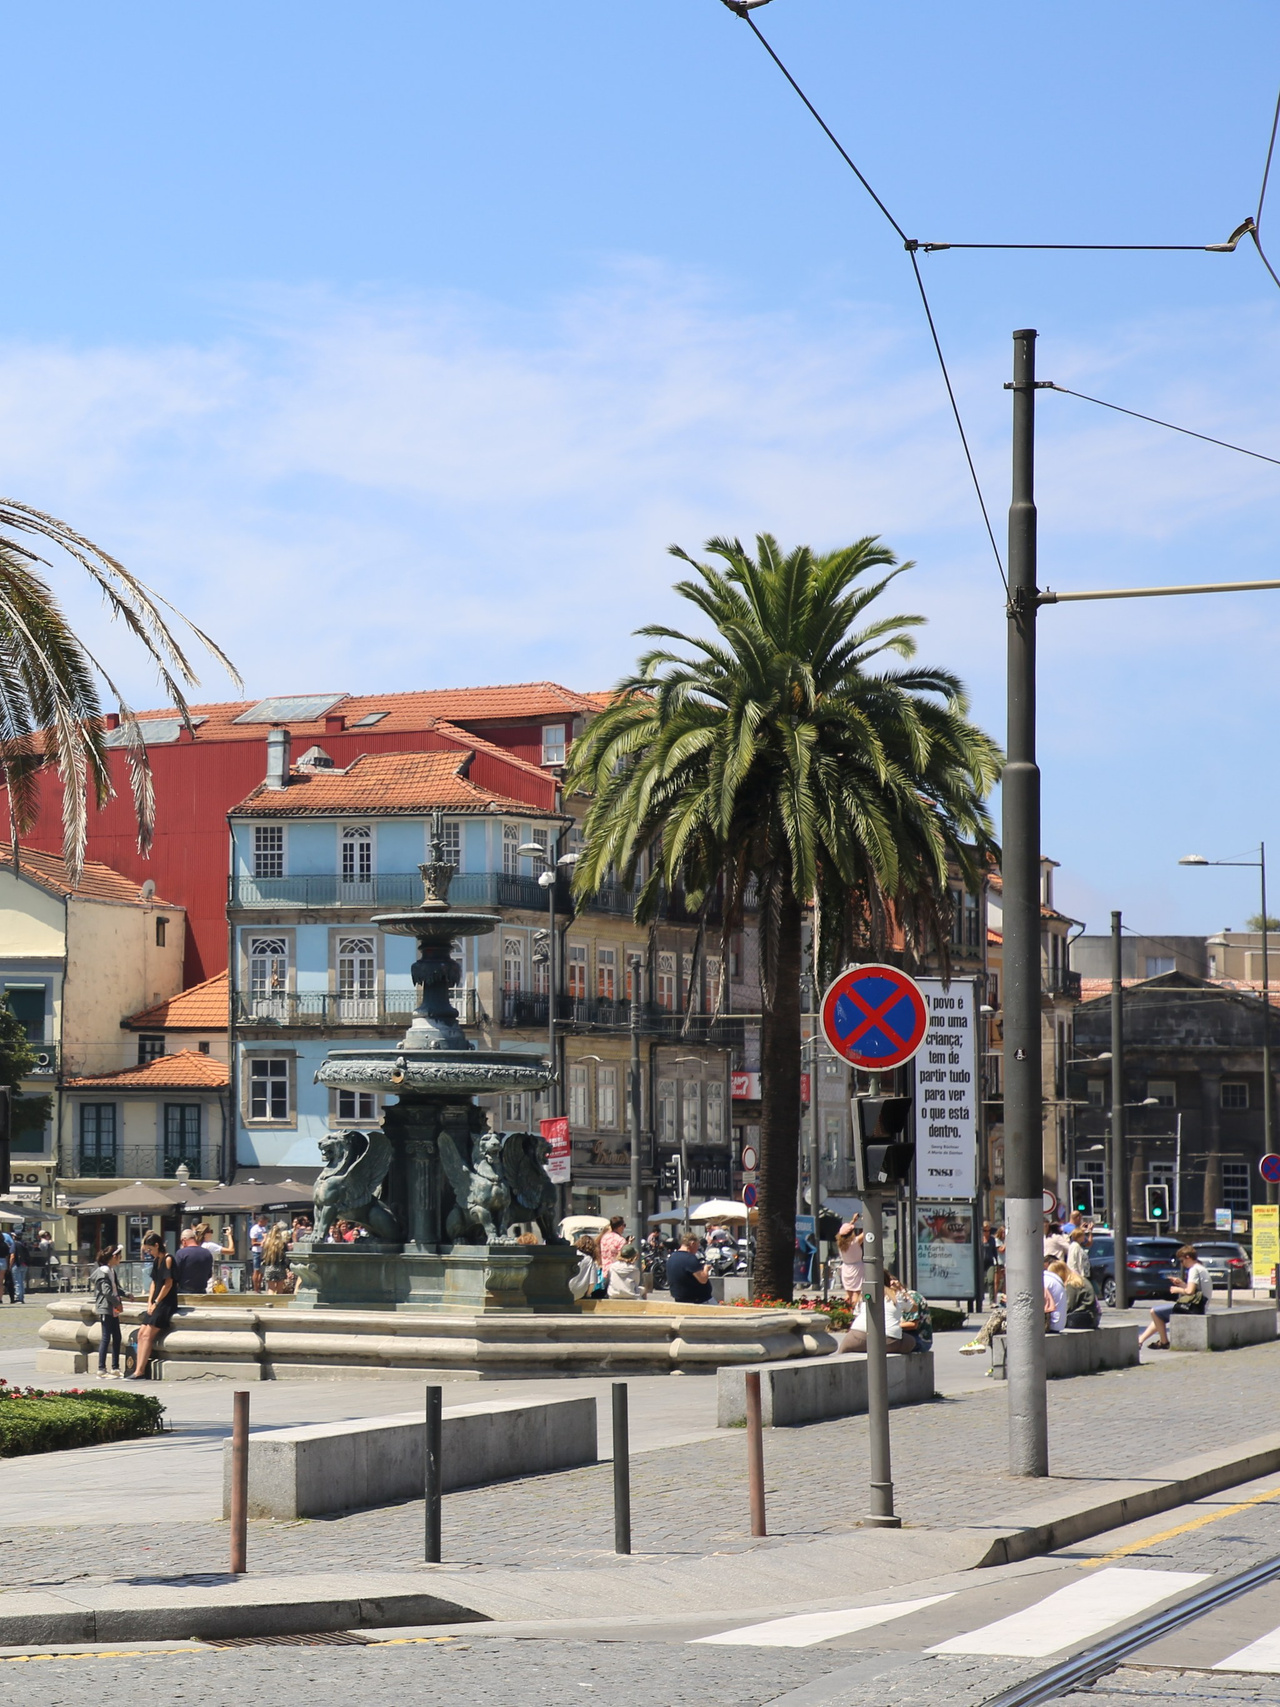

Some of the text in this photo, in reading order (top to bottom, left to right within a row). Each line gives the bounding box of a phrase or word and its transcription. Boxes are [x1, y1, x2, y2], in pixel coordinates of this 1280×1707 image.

[933, 997, 955, 1011] povo
[957, 995, 964, 1009] é
[947, 1016, 968, 1028] uma
[926, 1032, 963, 1050] criança;
[929, 1050, 960, 1064] tem de
[920, 1069, 971, 1084] partir tudo
[924, 1089, 965, 1103] para ver
[921, 1105, 969, 1121] o que está
[928, 1123, 961, 1138] dentro.
[928, 1168, 954, 1177] TNSJ
